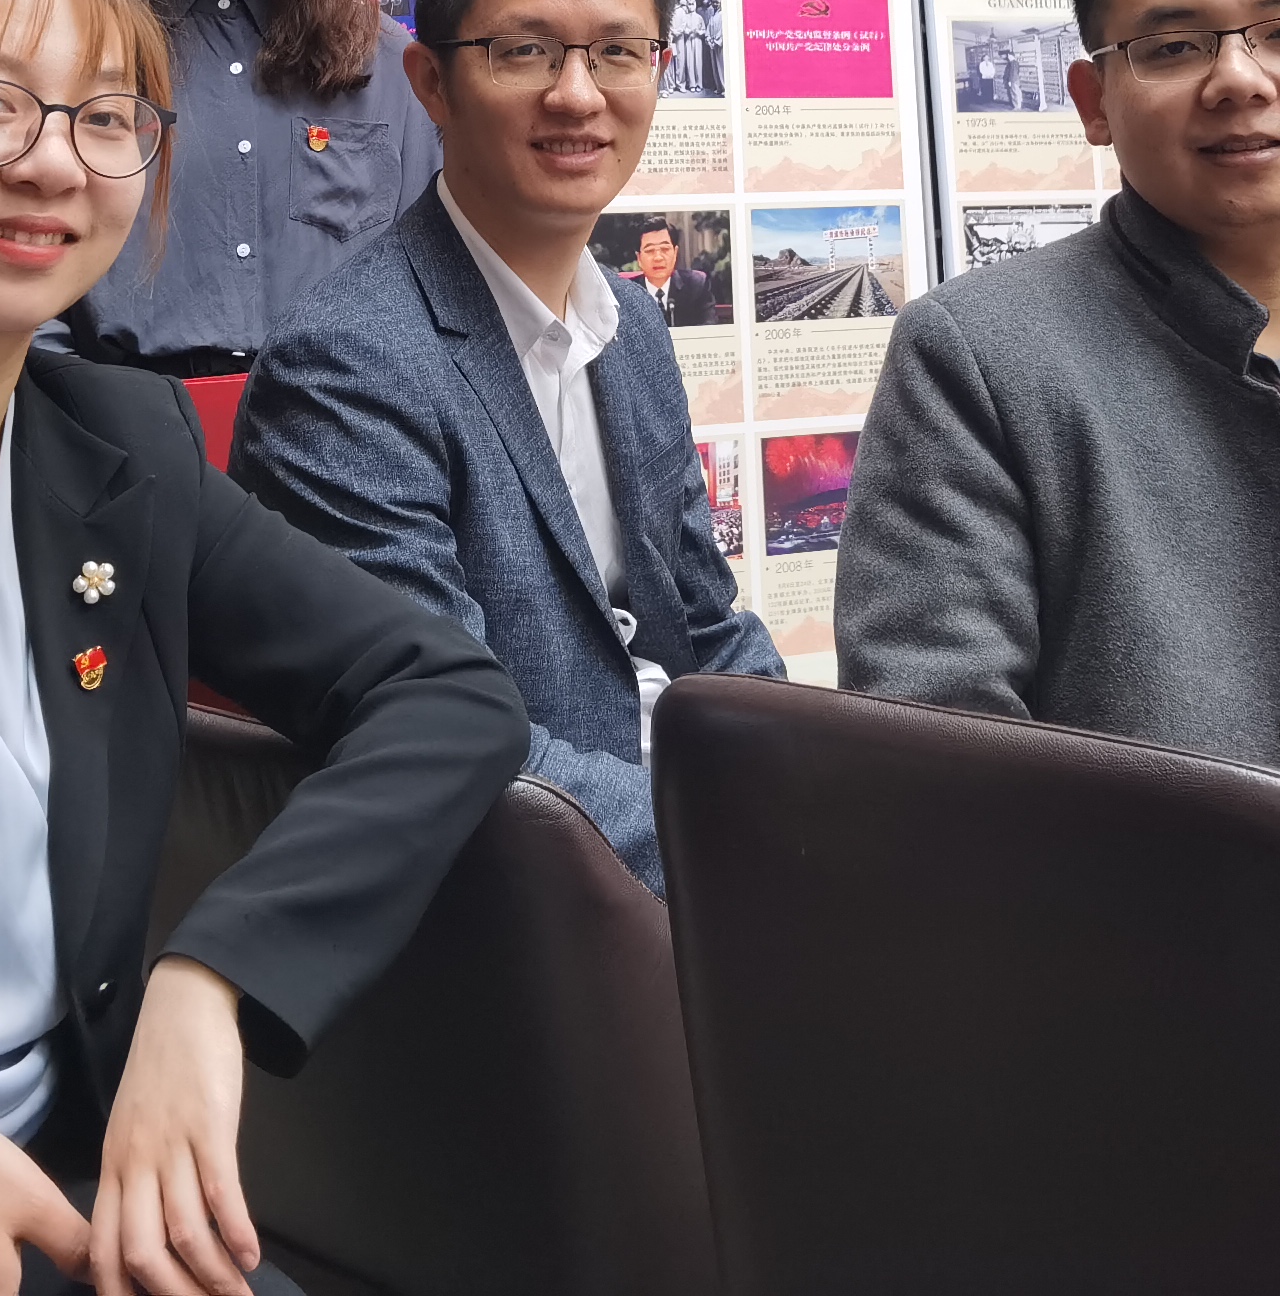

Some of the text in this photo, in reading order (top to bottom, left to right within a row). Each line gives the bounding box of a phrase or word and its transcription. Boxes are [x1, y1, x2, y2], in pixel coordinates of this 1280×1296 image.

[754, 104, 792, 116] 2004年
[965, 117, 998, 129] 1973年
[764, 327, 803, 341] 2006年
[775, 559, 814, 574] 2008年
